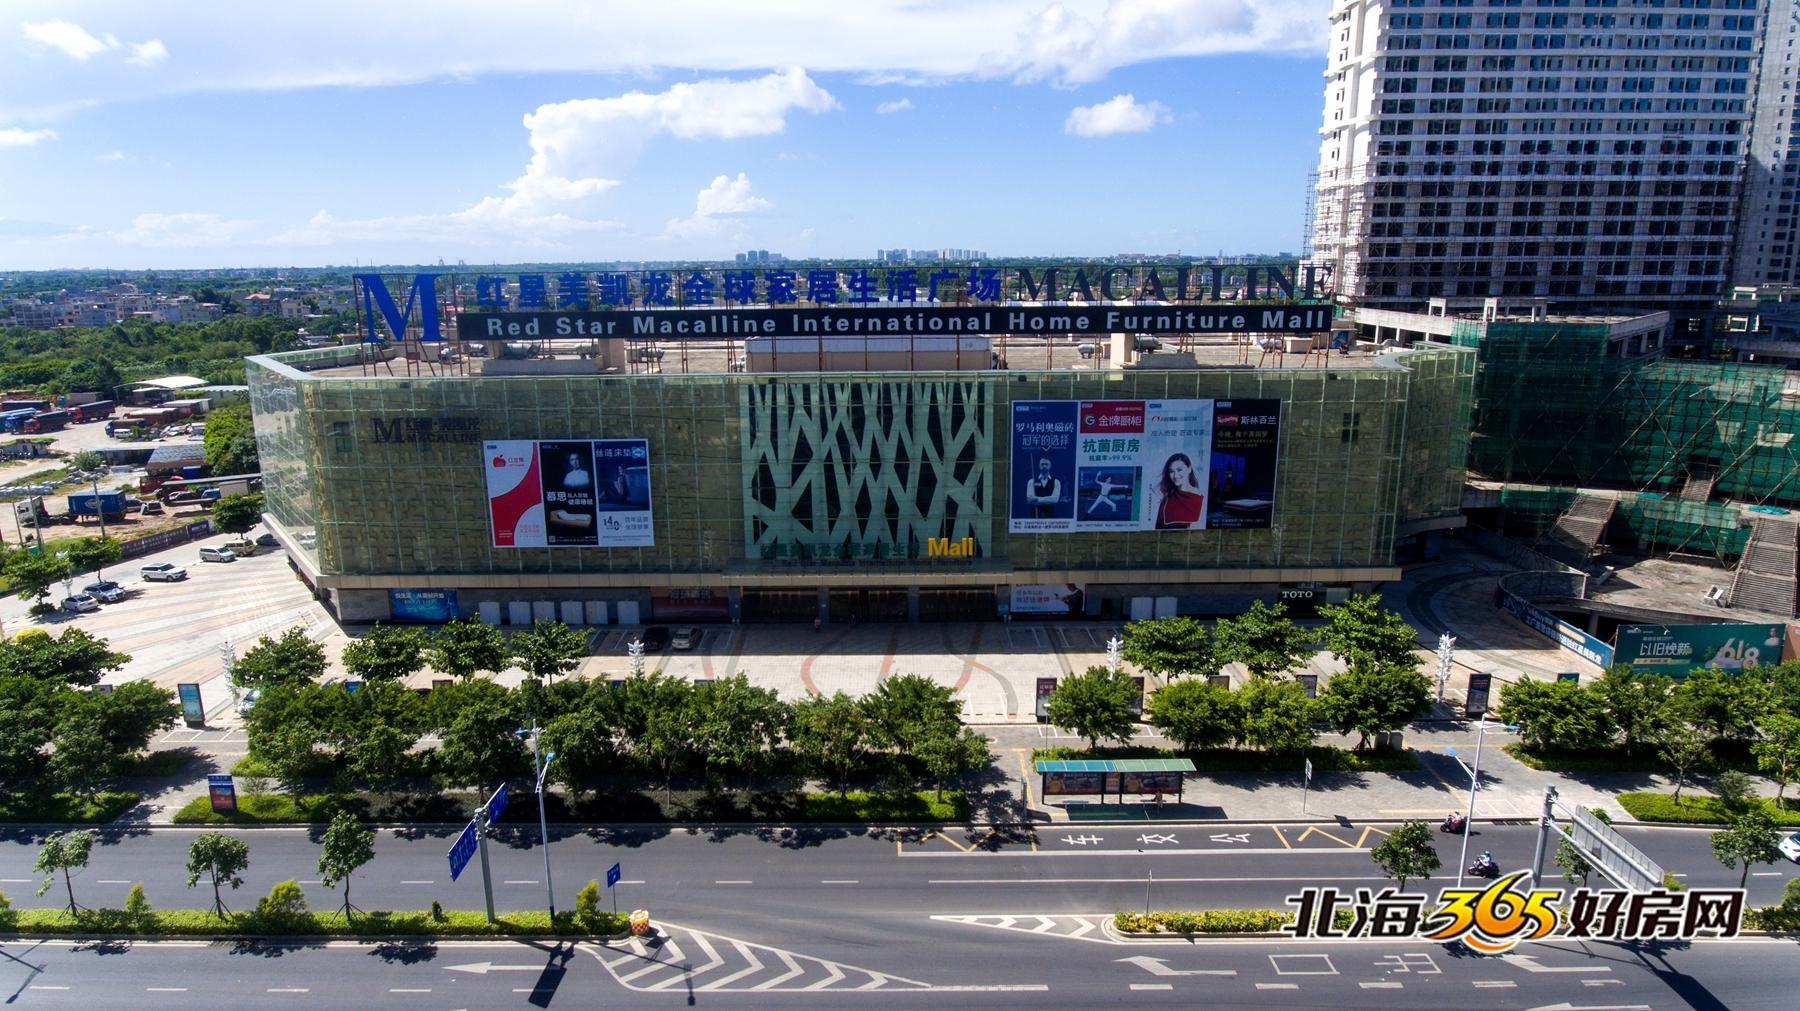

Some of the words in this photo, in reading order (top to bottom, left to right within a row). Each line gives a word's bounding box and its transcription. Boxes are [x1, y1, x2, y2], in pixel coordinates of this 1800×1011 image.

[476, 268, 1000, 308] 红星美凯龙全球家居生活广场
[1018, 265, 1334, 302] MACALLINE
[352, 273, 444, 342] M
[487, 317, 539, 336] Red
[556, 316, 616, 336] Star
[633, 315, 776, 333] Macalline
[793, 312, 991, 332] International
[1009, 312, 1090, 331] Home
[1106, 310, 1245, 331] Furniture
[1262, 310, 1325, 330] Mall
[1022, 434, 1069, 446] 冠军的选择
[1082, 438, 1141, 454] 抗菌厨房
[928, 537, 974, 557] Mall
[1281, 590, 1313, 599] TOTO
[1638, 641, 1692, 657] 以旧焕新
